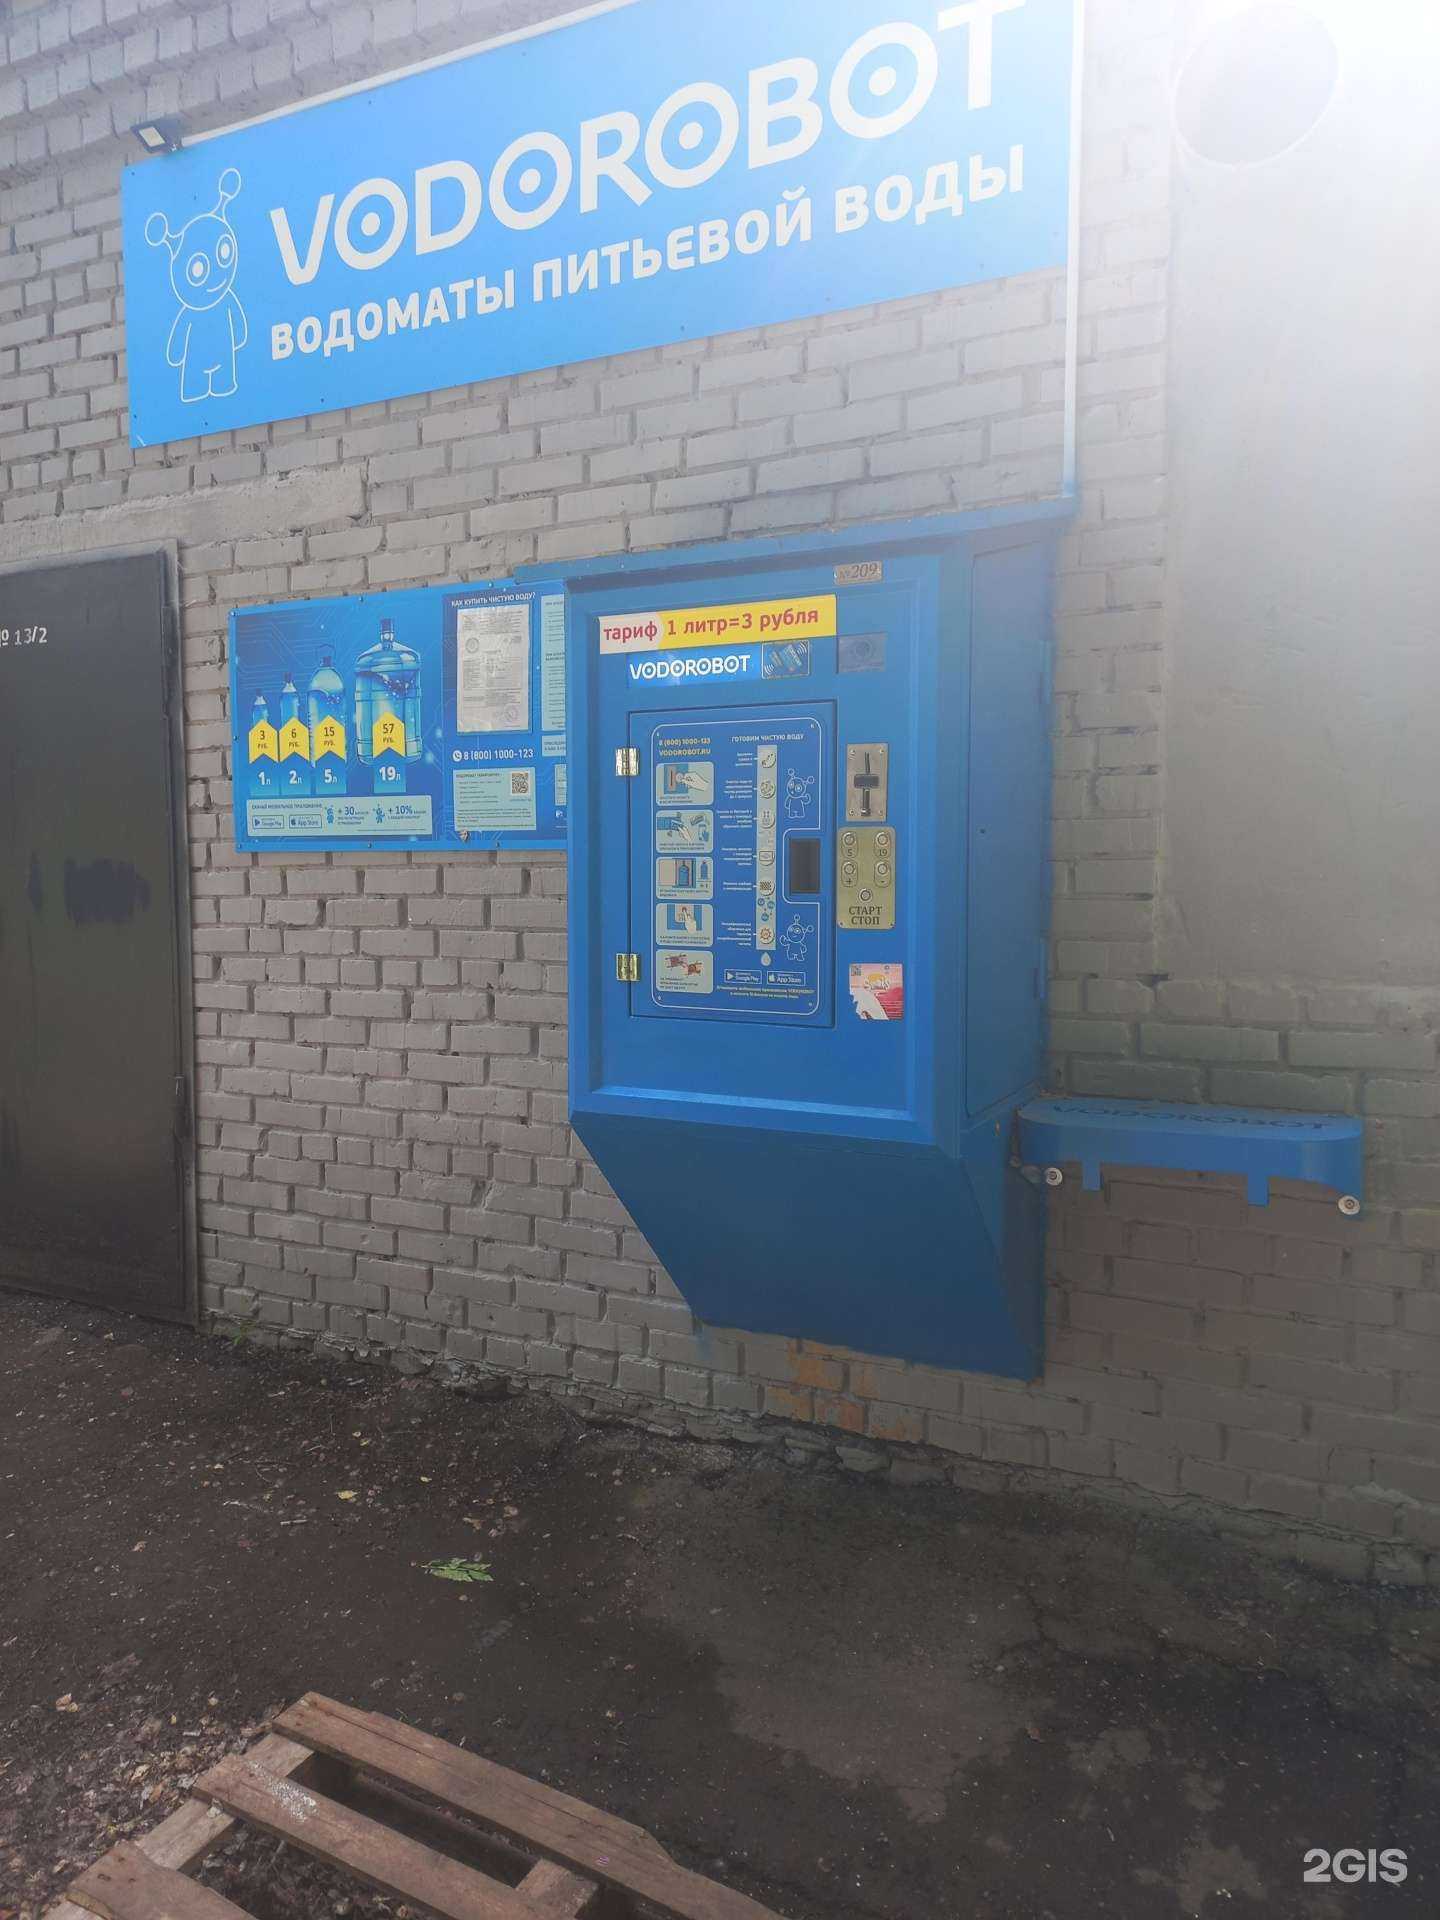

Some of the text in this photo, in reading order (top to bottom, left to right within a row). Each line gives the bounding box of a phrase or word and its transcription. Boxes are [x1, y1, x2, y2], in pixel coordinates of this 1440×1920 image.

[269, 0, 1027, 286] VODOROBOT
[271, 144, 1024, 360] ВОДОМАТЫ ПИТЬЕВОЙ ВОДЫ
[851, 562, 878, 579] 209
[451, 591, 536, 608] КАК КУПИТЬ ЧИСТУЮ ВОДУ?
[603, 621, 658, 641] тариф
[668, 620, 677, 635] 1
[760, 608, 819, 632] рубля
[15, 625, 48, 646] 13/2
[629, 655, 751, 680] VODOROBOT
[291, 728, 297, 739] 6
[324, 726, 335, 738] 15
[382, 723, 394, 735] 57
[259, 730, 266, 741] 3
[382, 736, 395, 744] РУБ.
[731, 735, 760, 743] ГОТОВИМ
[761, 734, 786, 742] ЧИСТУЮ
[288, 740, 300, 748] РУБ.
[323, 738, 336, 747] РУБ.
[463, 751, 470, 761] 8
[471, 750, 492, 761] (800)
[495, 748, 534, 760] 1000-123
[659, 748, 711, 757] VODOROBOT.RU
[345, 806, 355, 816] 30
[395, 804, 413, 815] 10%
[847, 848, 888, 857] 5 19
[849, 906, 883, 916] СТАРТ
[851, 916, 880, 926] СТОП
